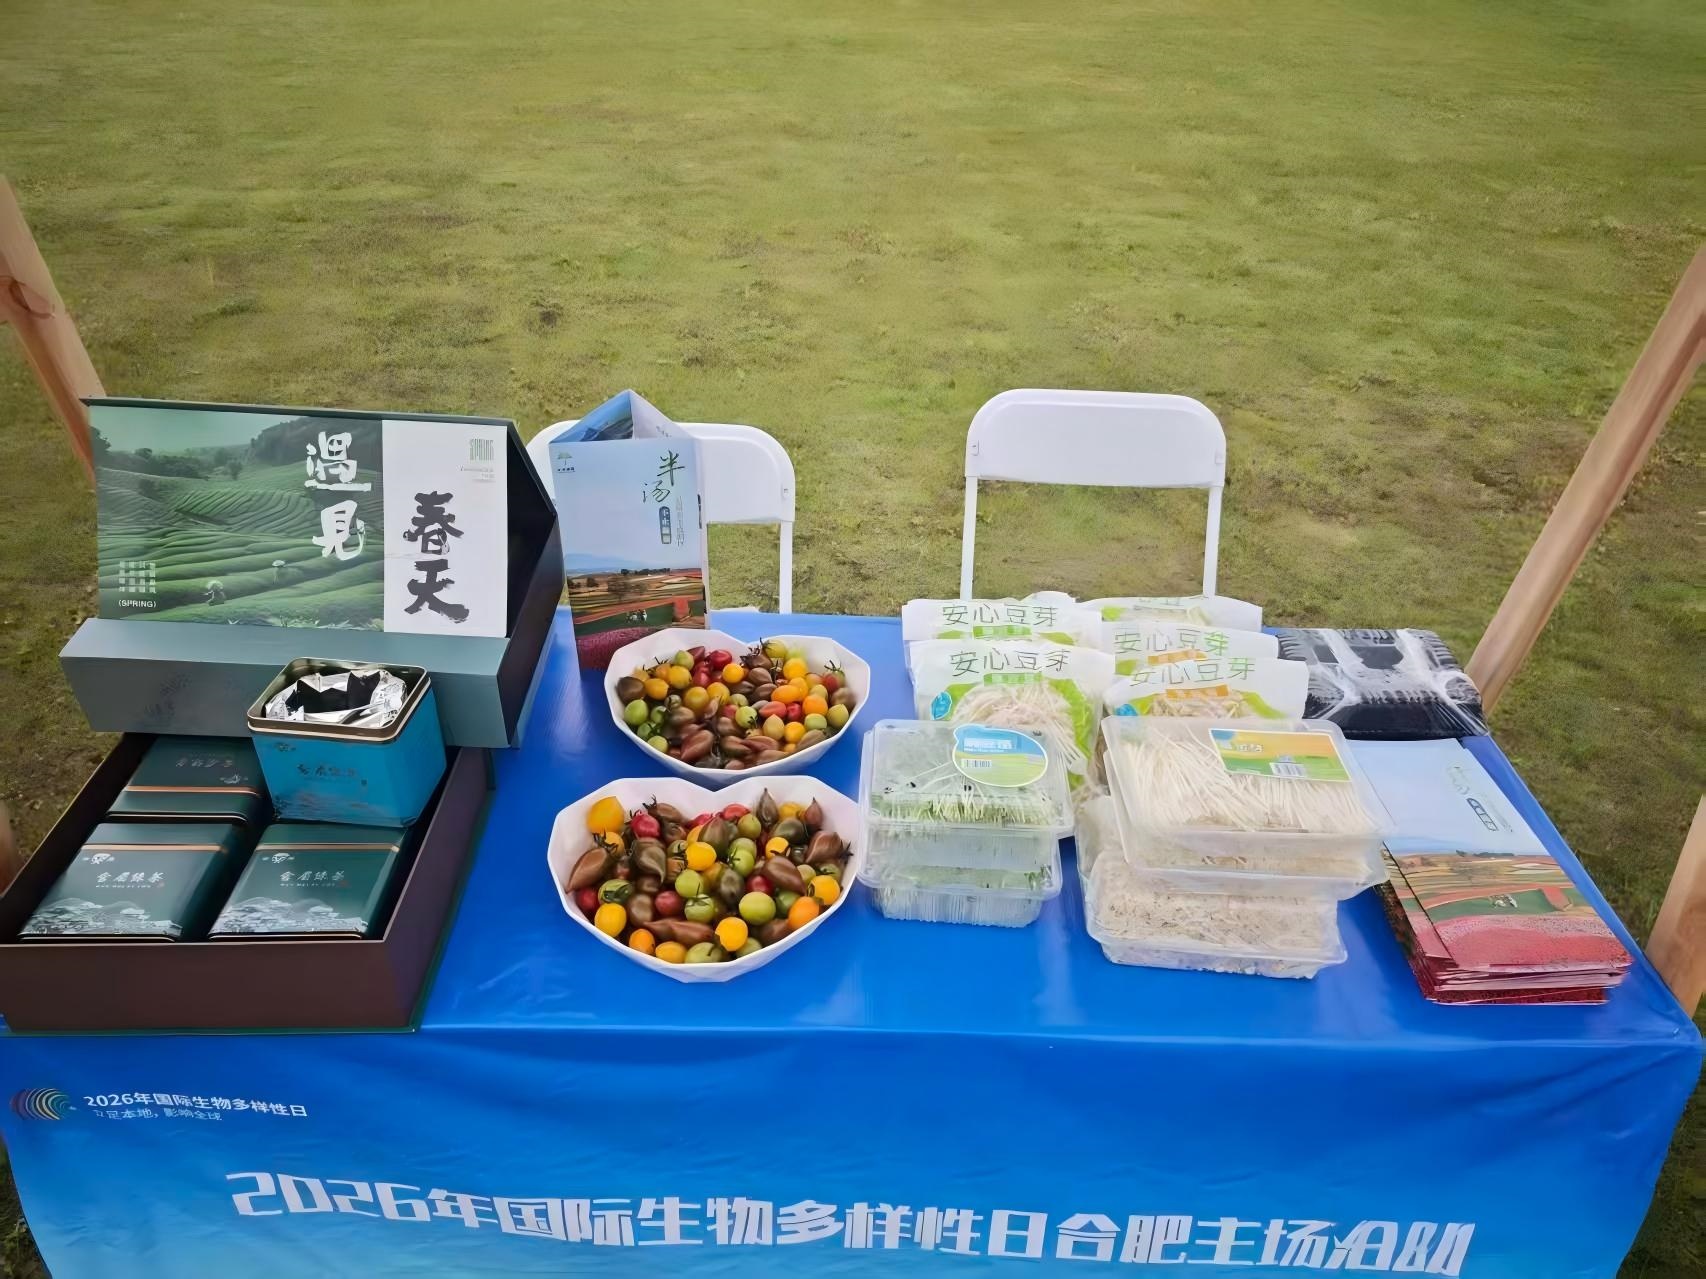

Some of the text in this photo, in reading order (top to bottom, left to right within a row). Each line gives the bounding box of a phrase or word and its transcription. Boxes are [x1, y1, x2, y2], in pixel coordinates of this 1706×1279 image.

[403, 491, 469, 624] 春天
[943, 602, 1058, 627] 安心豆芽
[1114, 627, 1230, 656] 安心豆芽
[83, 1092, 308, 1117] 2026年国际生物多样性日
